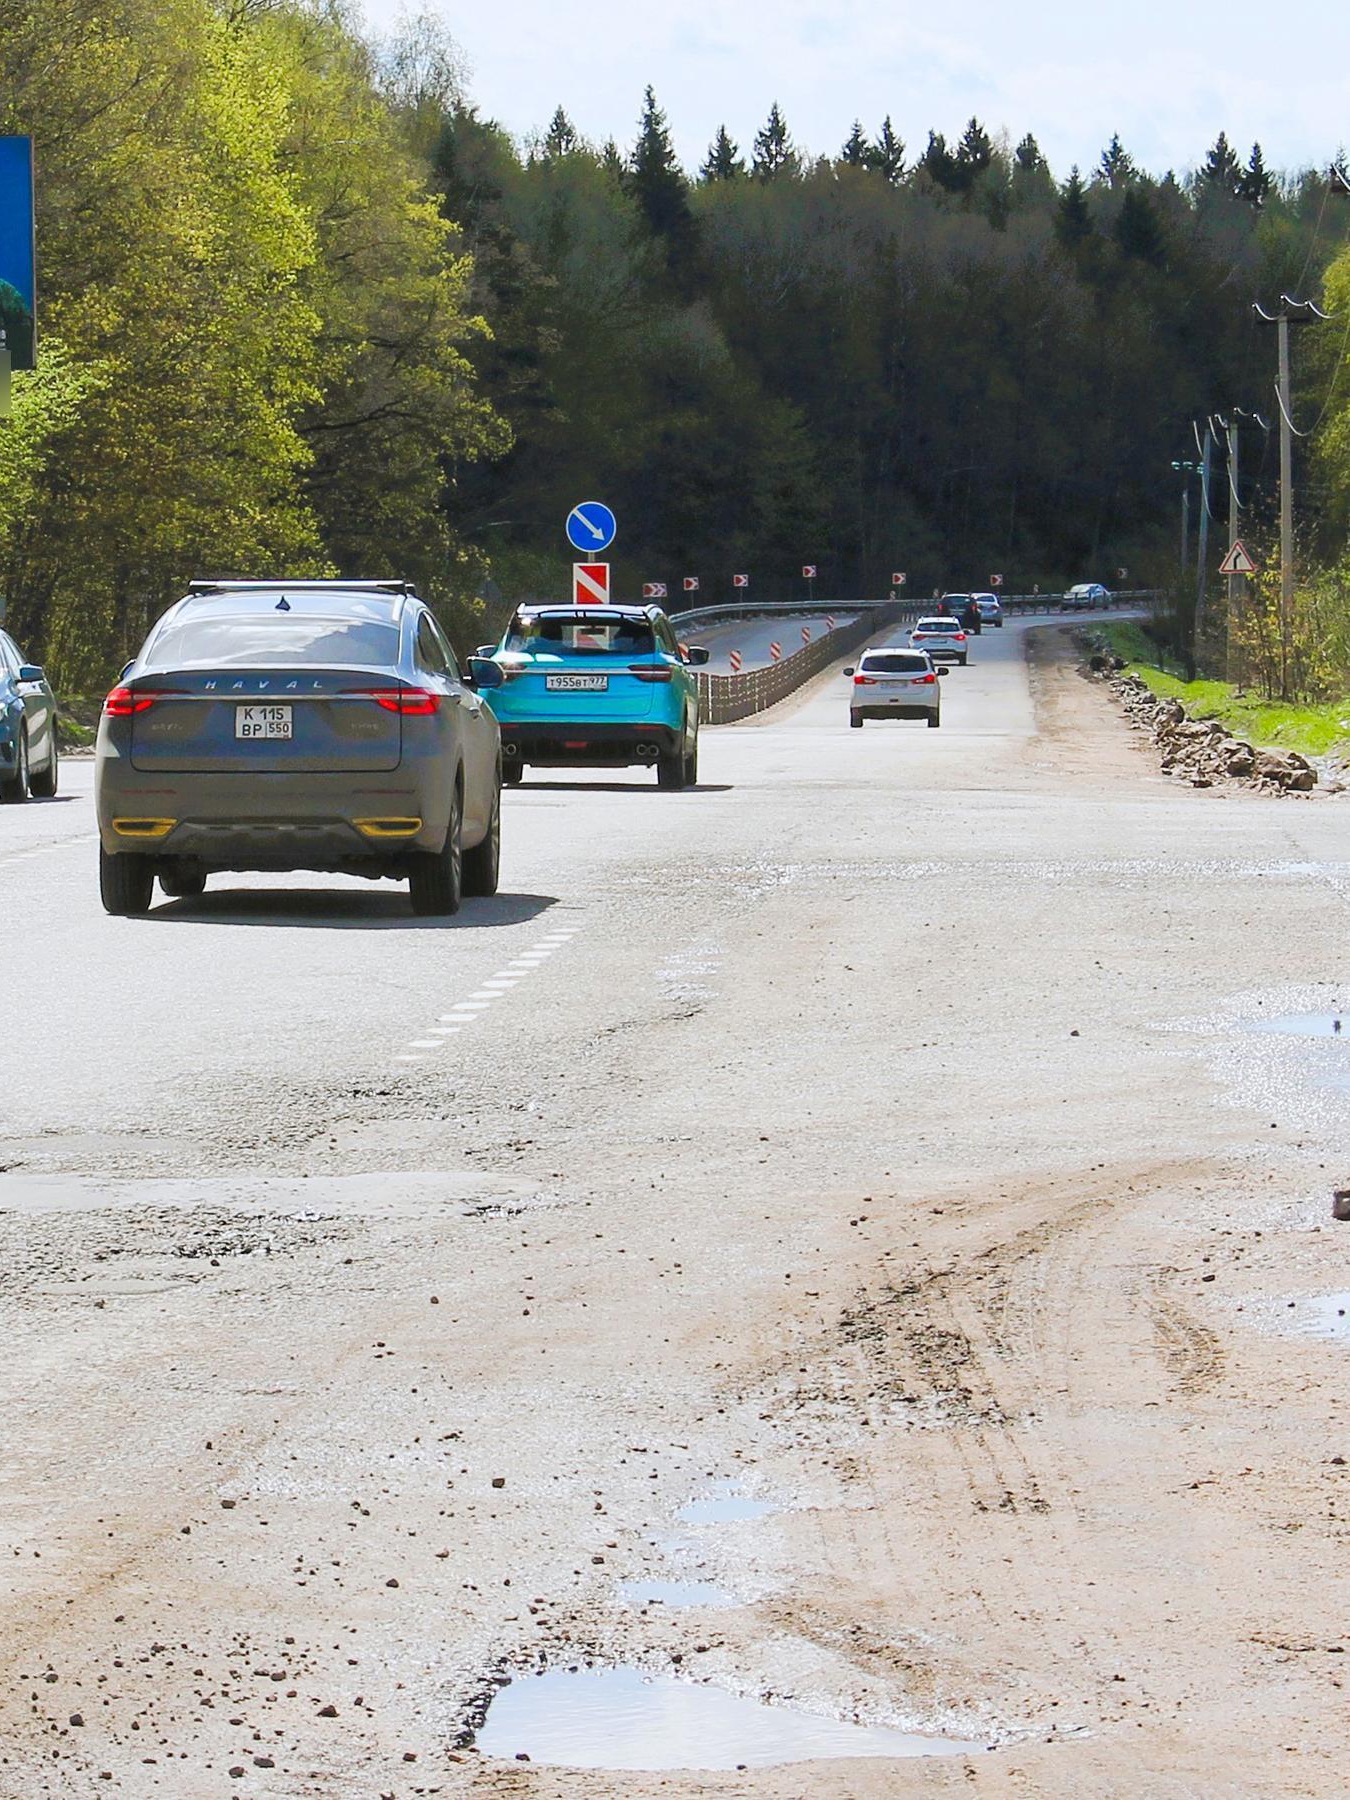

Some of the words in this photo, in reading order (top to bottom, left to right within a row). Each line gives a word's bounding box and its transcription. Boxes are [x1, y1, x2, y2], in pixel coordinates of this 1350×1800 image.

[205, 680, 323, 689] HAVAL
[244, 707, 254, 720] К
[259, 707, 284, 720] 115
[242, 723, 262, 736] ВР
[268, 723, 290, 733] 550
